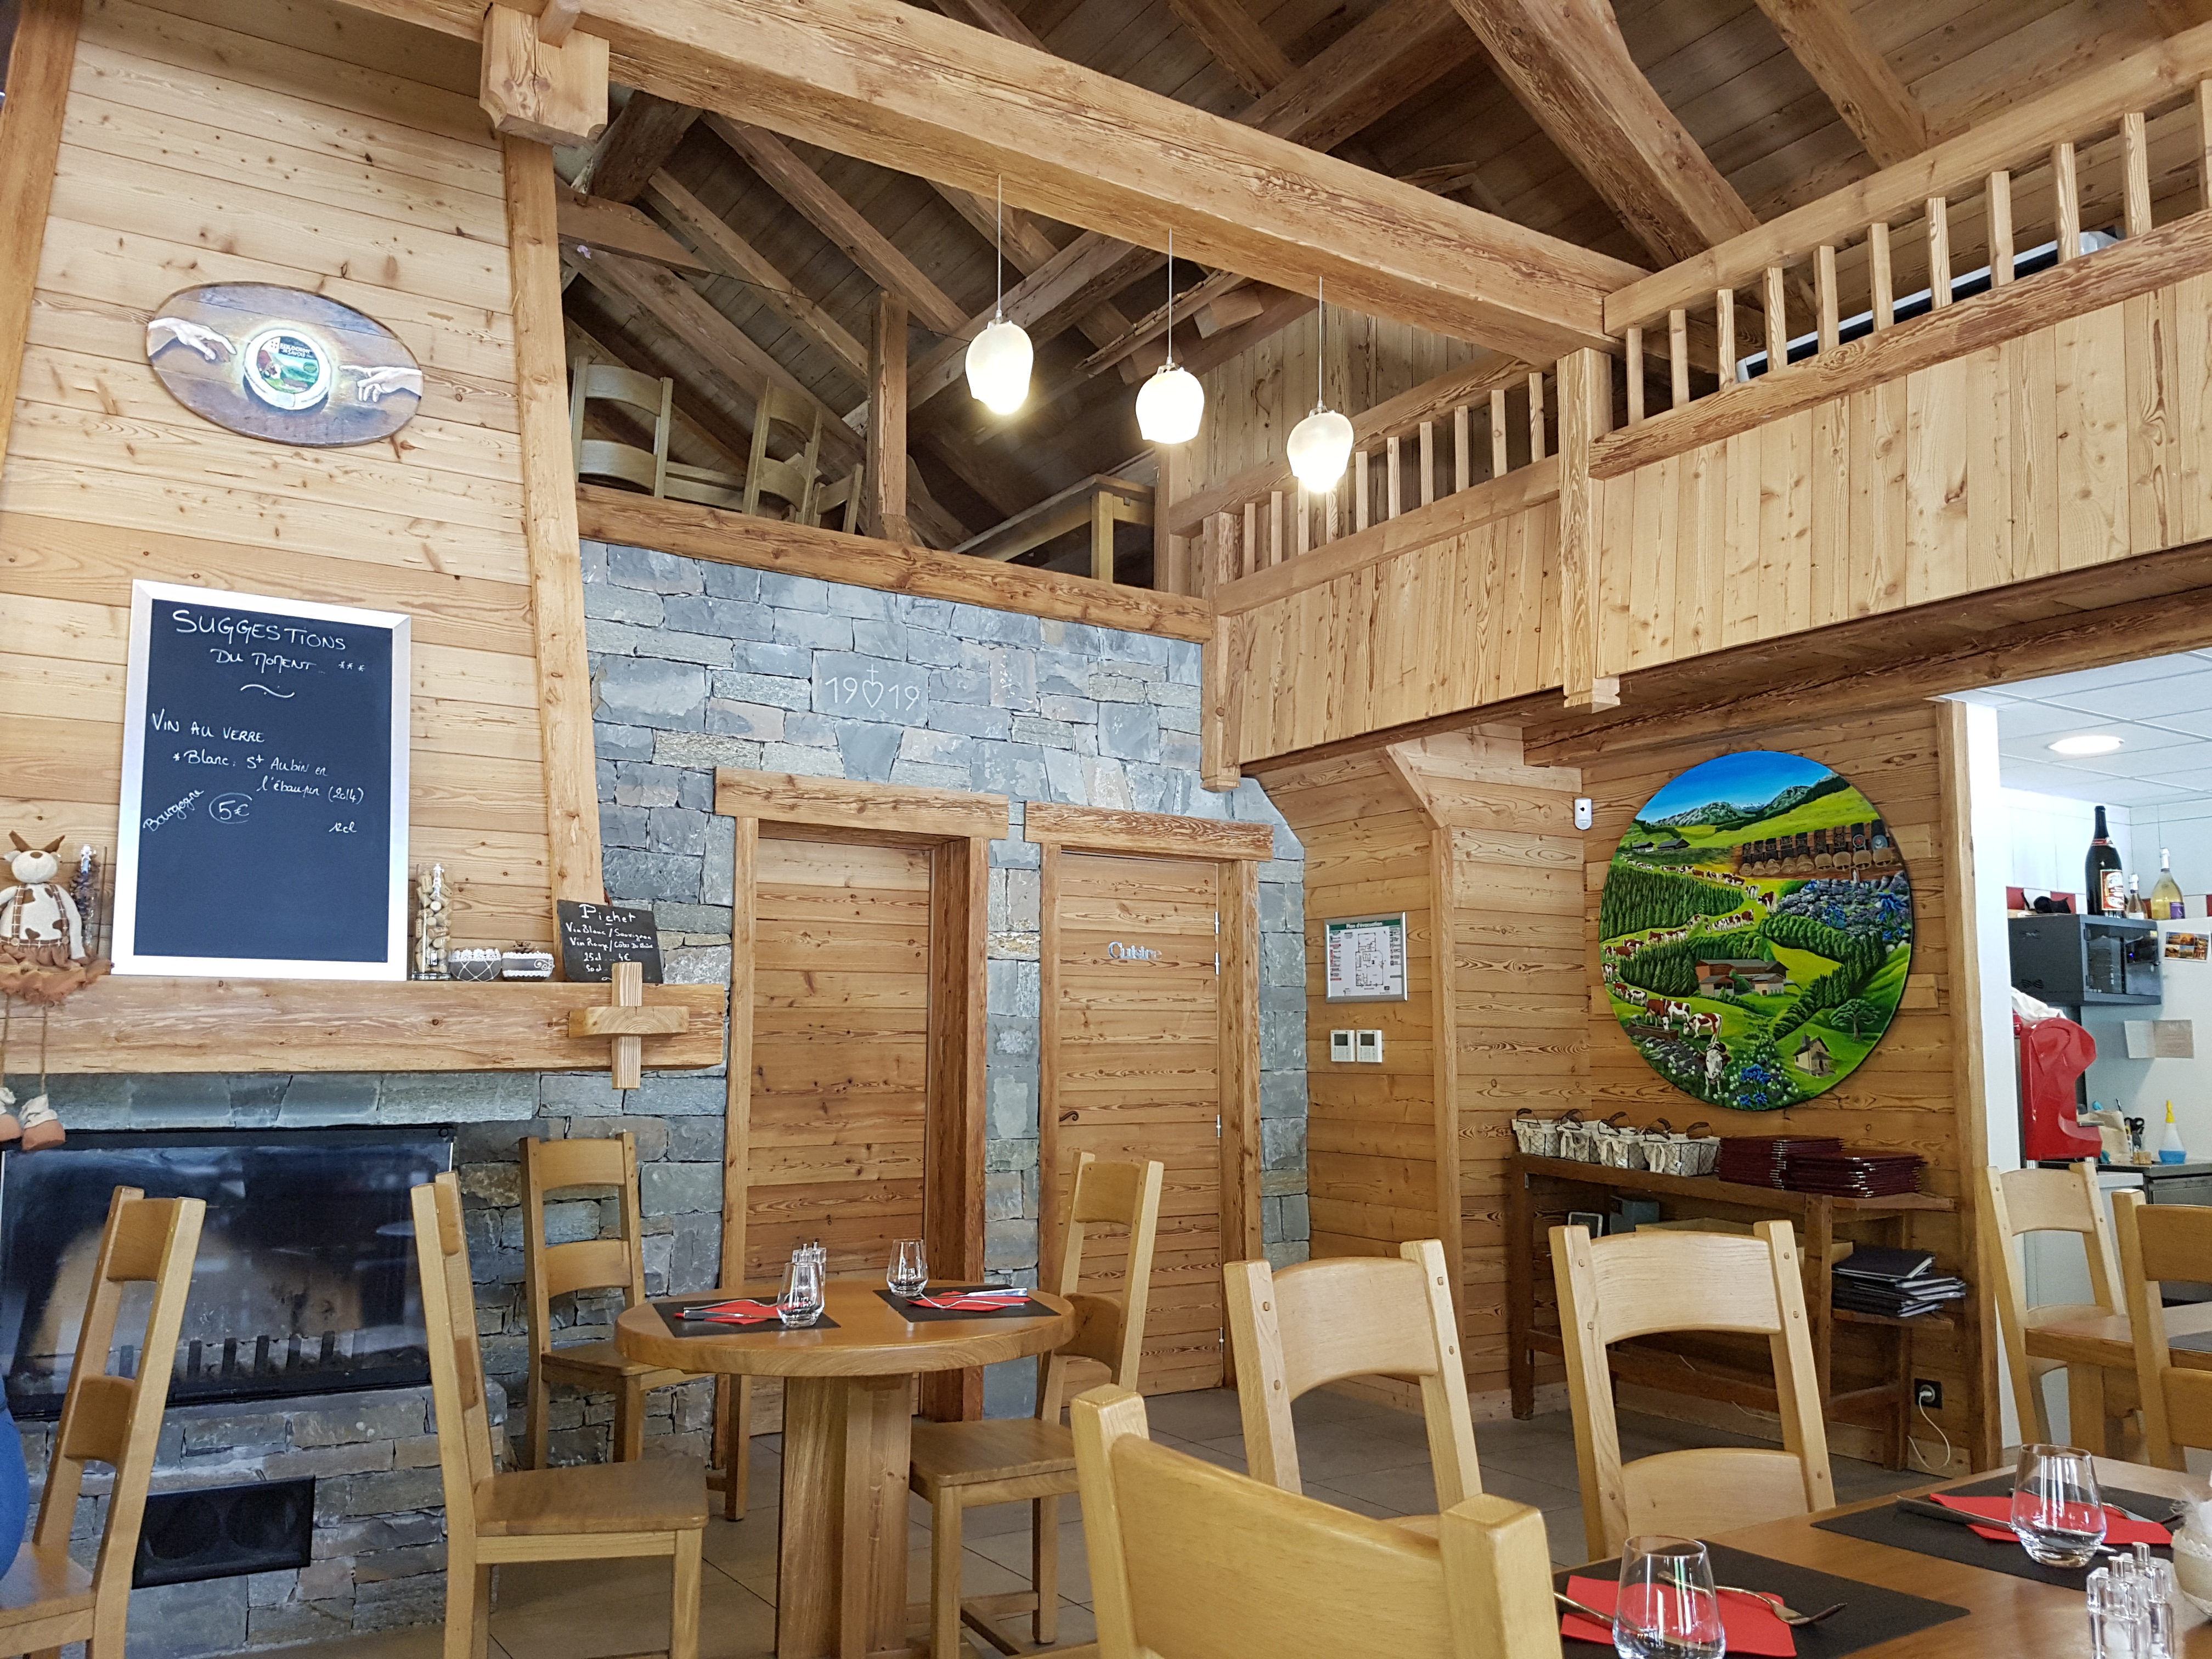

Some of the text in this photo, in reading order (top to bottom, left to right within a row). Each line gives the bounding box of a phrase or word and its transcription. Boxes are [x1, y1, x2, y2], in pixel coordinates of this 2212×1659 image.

[173, 610, 346, 651] SUGGESTIONS
[190, 721, 215, 738] AU
[223, 727, 266, 743] VERRE
[328, 786, 364, 805] (2014)
[219, 800, 250, 820] 5€
[579, 904, 636, 923] Pichet
[566, 922, 582, 933] Vin
[569, 937, 585, 946] Vin
[1108, 940, 1163, 960] Cuisine
